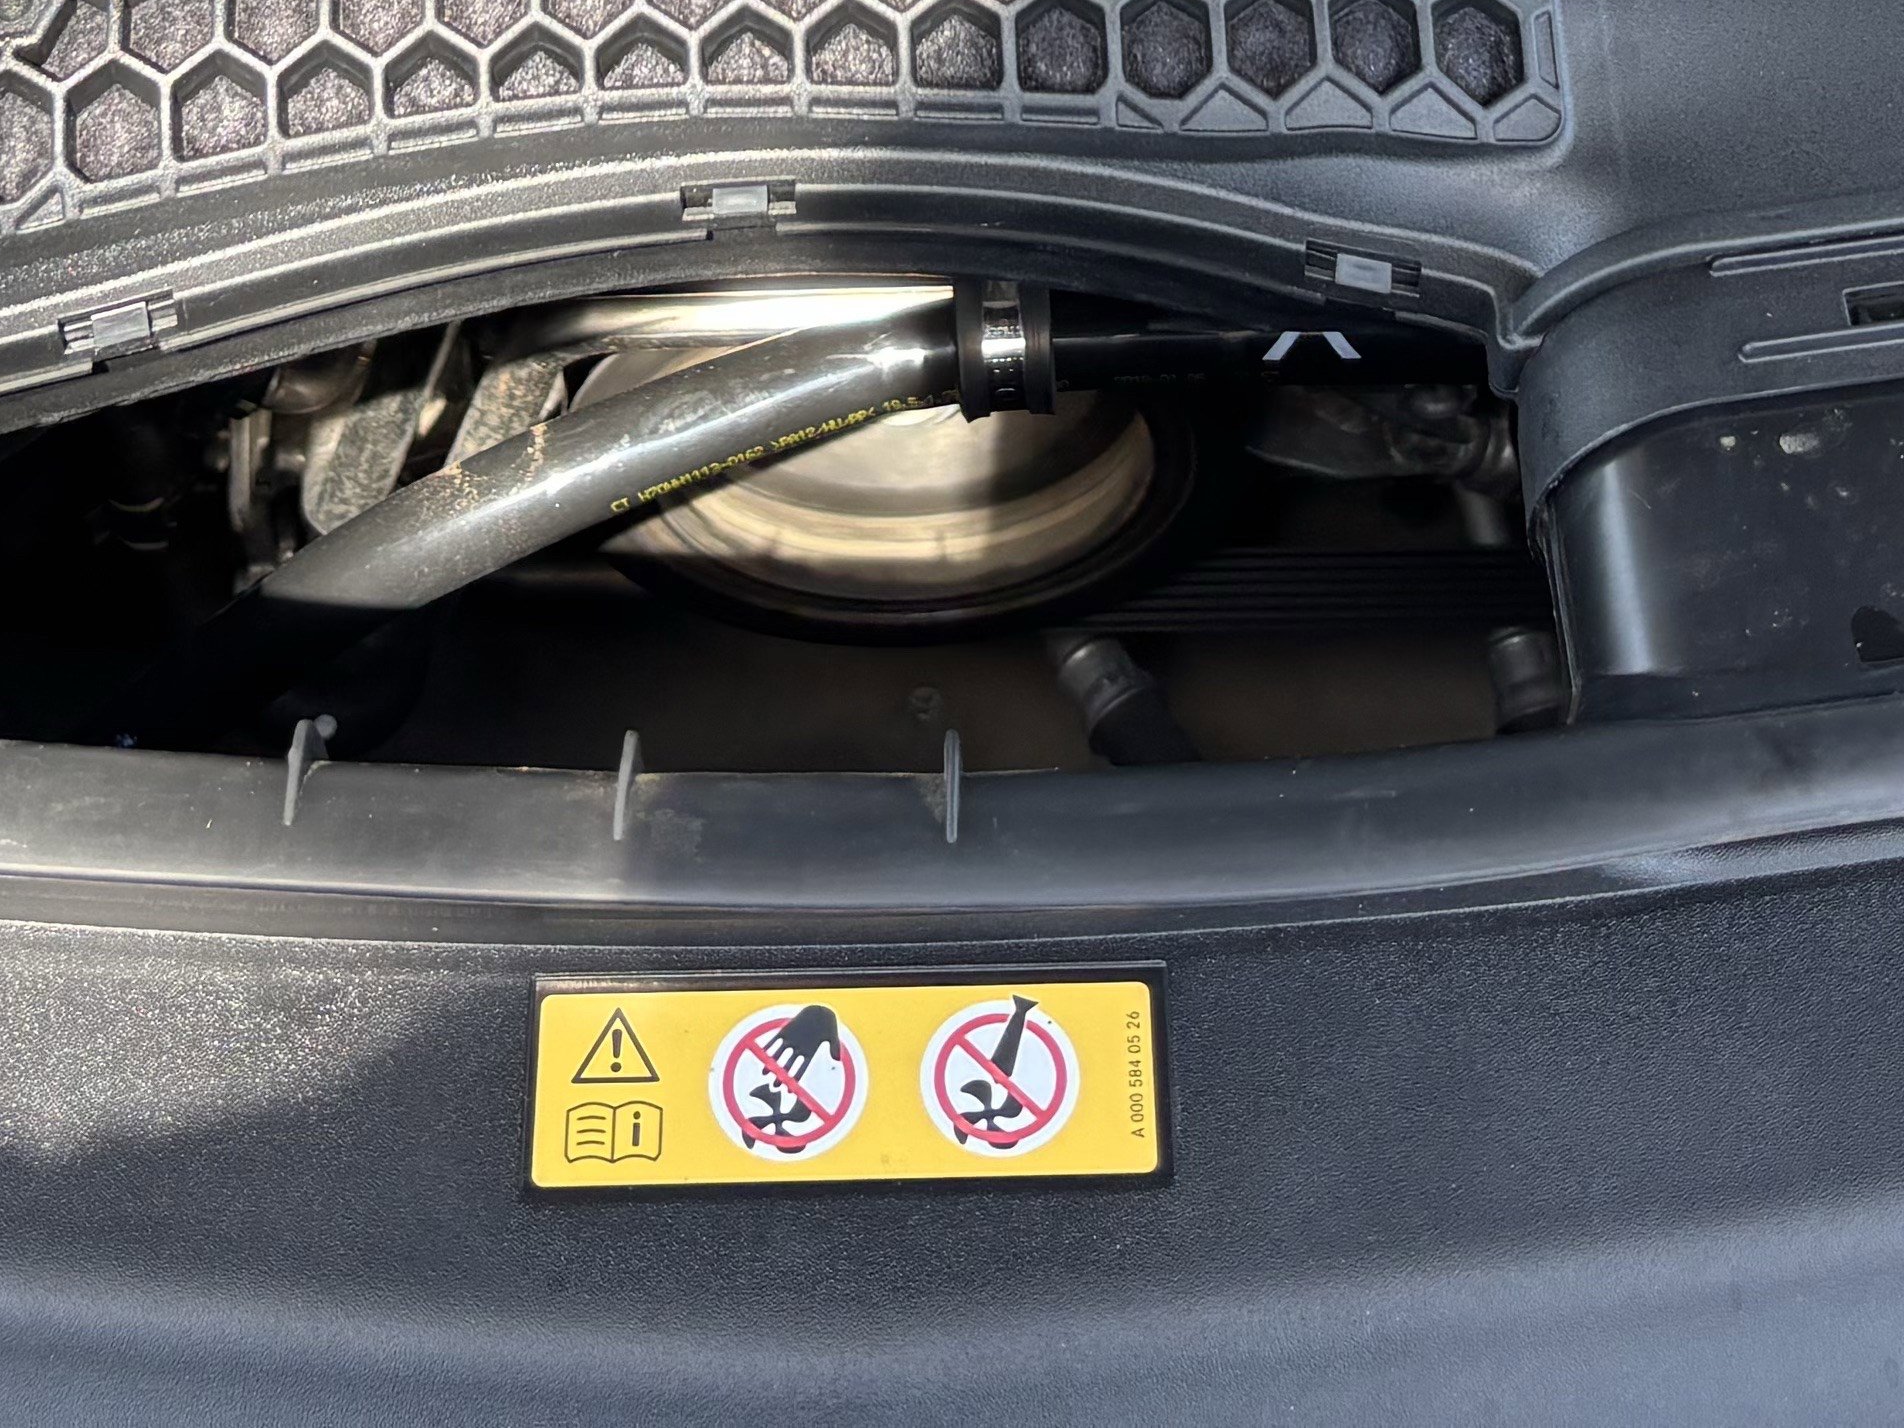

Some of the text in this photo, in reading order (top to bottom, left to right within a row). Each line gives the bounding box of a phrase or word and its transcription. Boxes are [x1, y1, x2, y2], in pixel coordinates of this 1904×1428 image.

[1125, 1010, 1145, 1138] A 000 584 05 26
